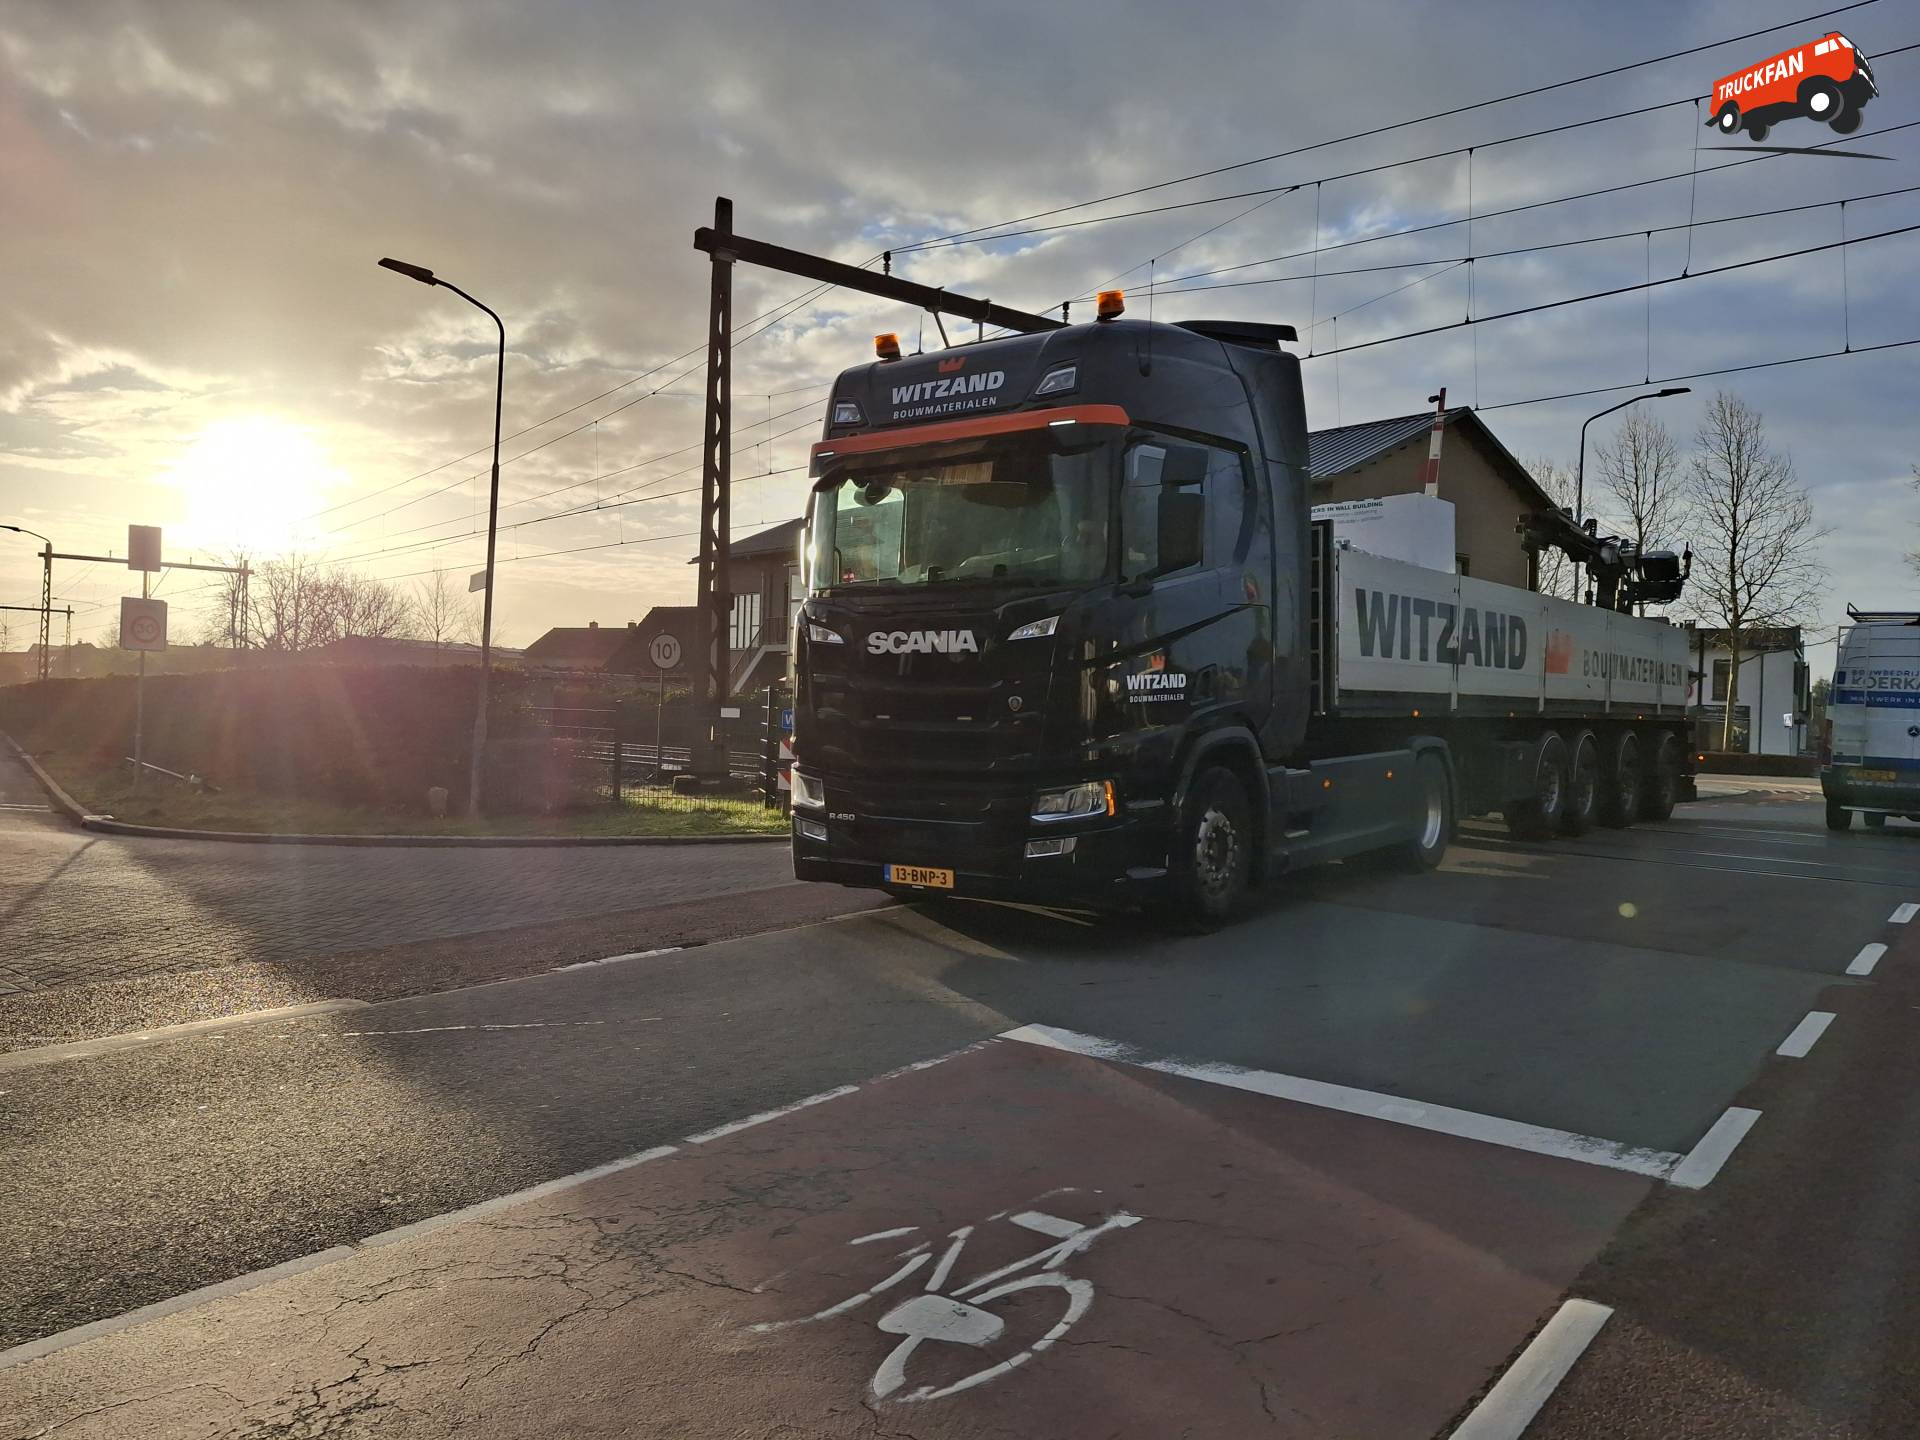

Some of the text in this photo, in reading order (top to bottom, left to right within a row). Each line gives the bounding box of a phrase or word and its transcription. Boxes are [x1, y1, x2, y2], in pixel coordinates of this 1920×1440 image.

[892, 371, 1005, 405] WITZAND
[893, 396, 997, 419] BOUWMATERIALEN
[1335, 504, 1351, 512] WALL
[1353, 501, 1383, 510] BUILDING
[1355, 588, 1528, 670] WITZAND
[867, 630, 978, 654] SCANIA
[1583, 649, 1682, 687] BOUWMATERIALEN
[1126, 673, 1187, 690] WITZAND
[1129, 693, 1185, 703] BOUWMATERIALEN
[829, 812, 856, 821] R 450
[895, 867, 948, 886] 13-BNP-3
